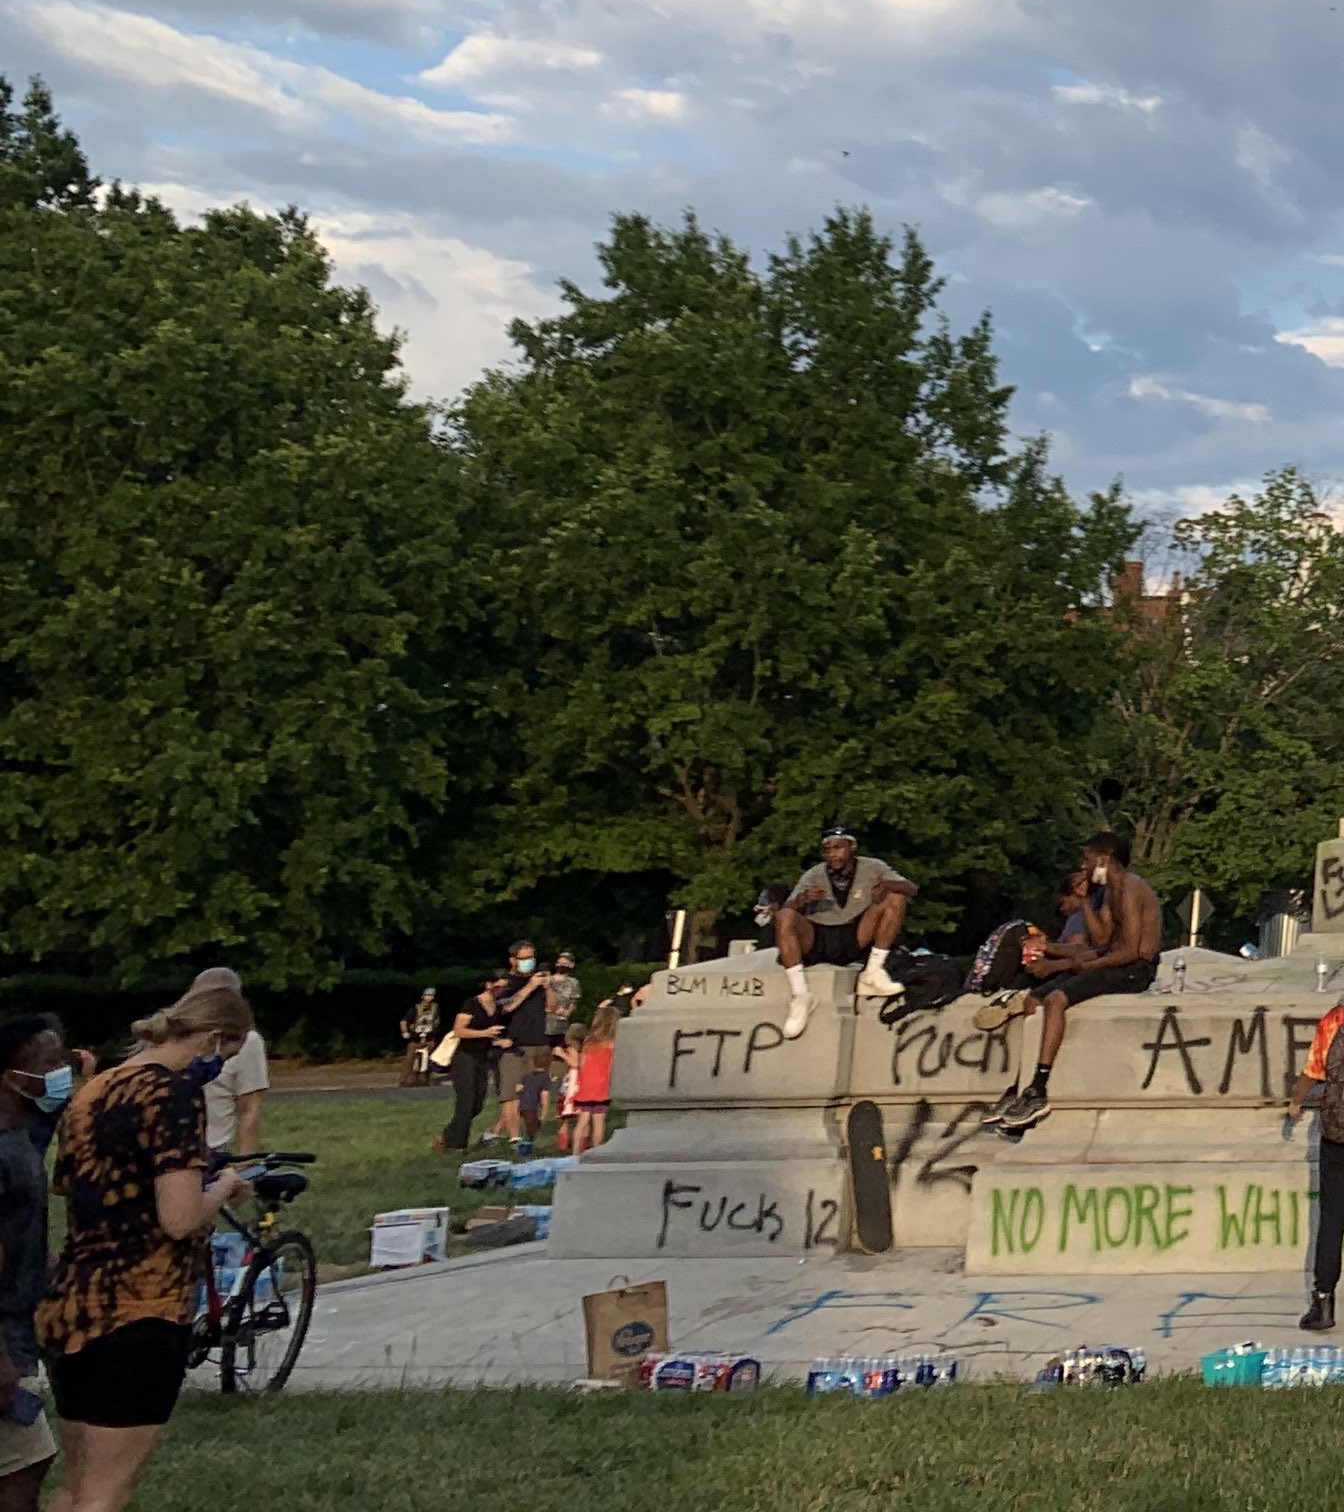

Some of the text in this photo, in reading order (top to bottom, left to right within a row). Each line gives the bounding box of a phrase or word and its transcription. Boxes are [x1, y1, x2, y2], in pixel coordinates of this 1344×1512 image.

[666, 973, 708, 996] BLM
[669, 1021, 785, 1089] FTP
[804, 1187, 839, 1251] 12
[991, 1186, 1045, 1255] NO
[1059, 1184, 1194, 1255] MORE
